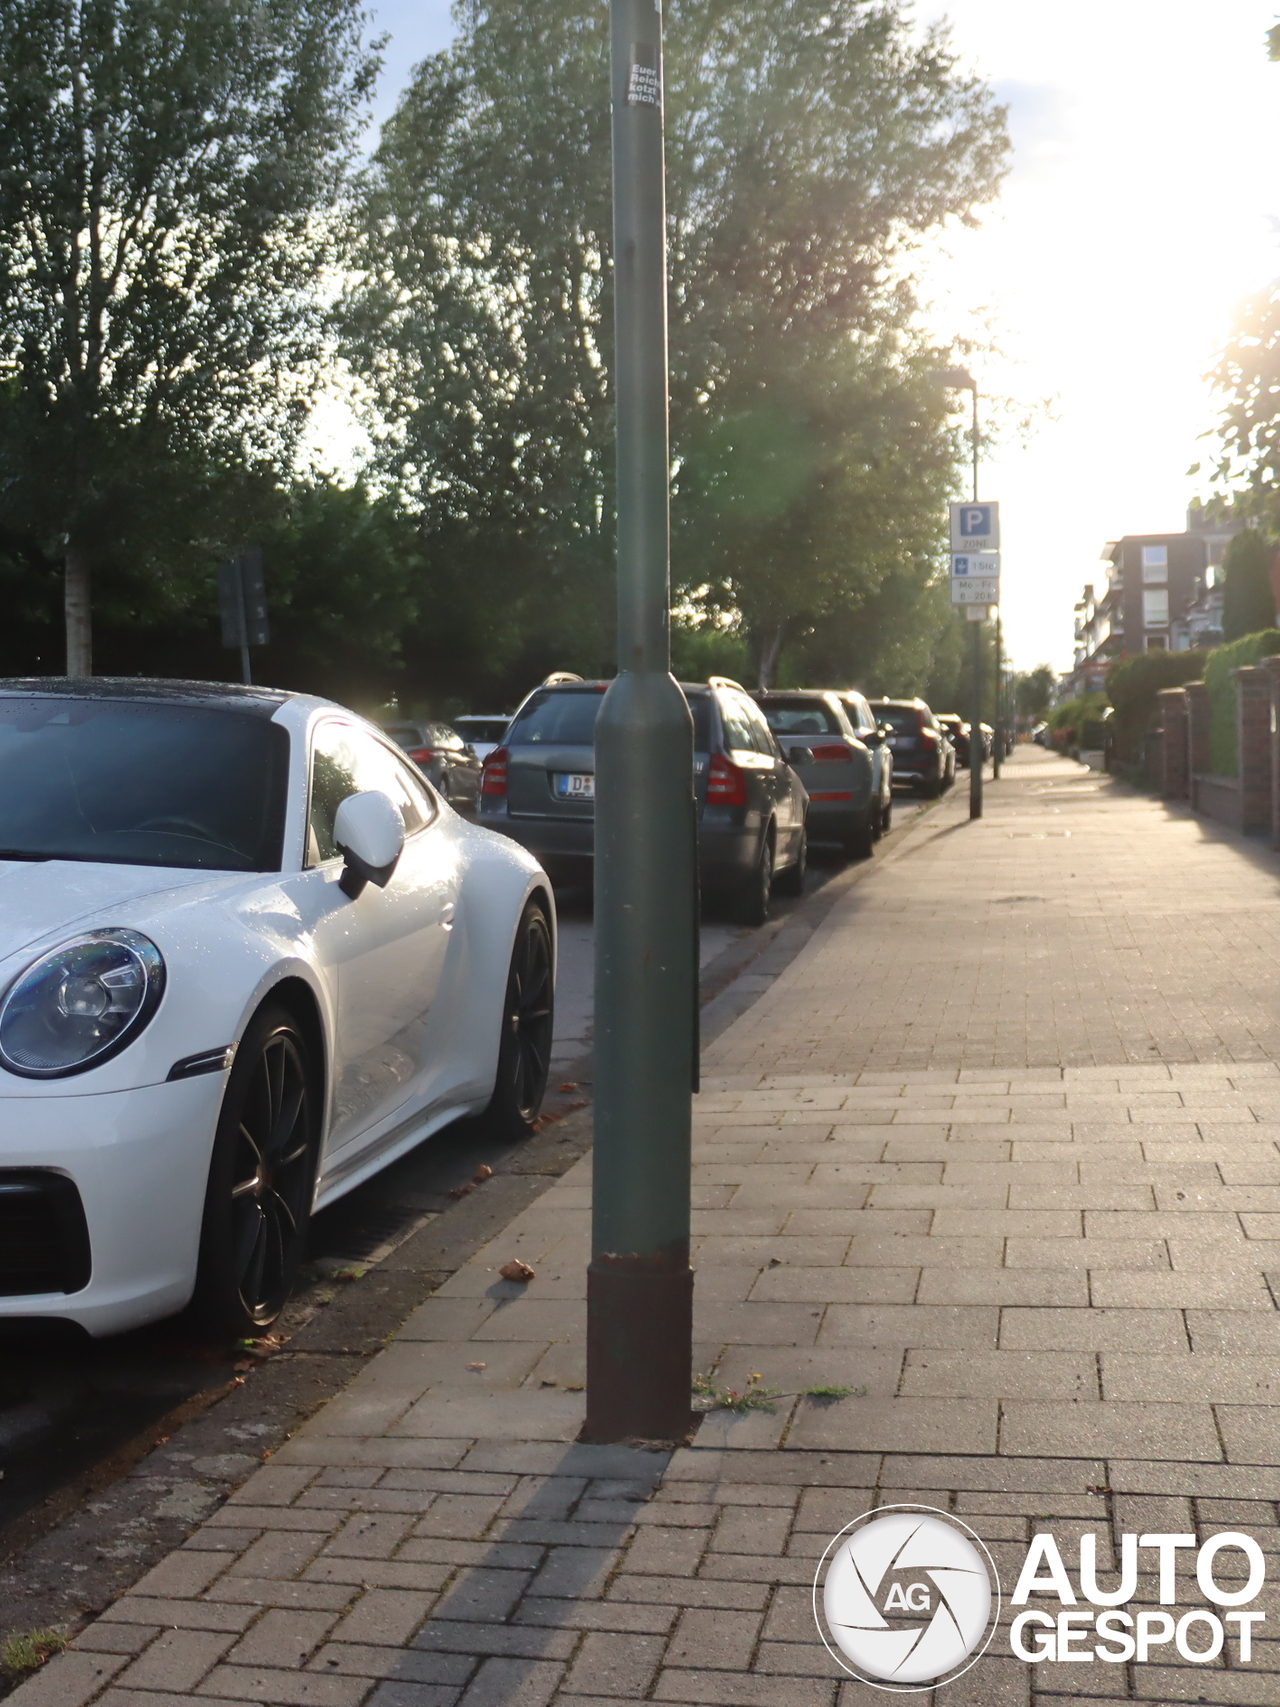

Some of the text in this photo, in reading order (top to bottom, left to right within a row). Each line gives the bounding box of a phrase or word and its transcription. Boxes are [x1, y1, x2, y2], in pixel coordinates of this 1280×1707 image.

[632, 64, 657, 76] Euer
[630, 73, 661, 88] Reich
[629, 82, 657, 95] kotzt
[628, 93, 655, 104] mich
[967, 510, 984, 533] P
[963, 540, 988, 549] ZONE
[960, 581, 972, 589] Mo
[982, 580, 992, 588] Fr
[573, 777, 582, 791] D
